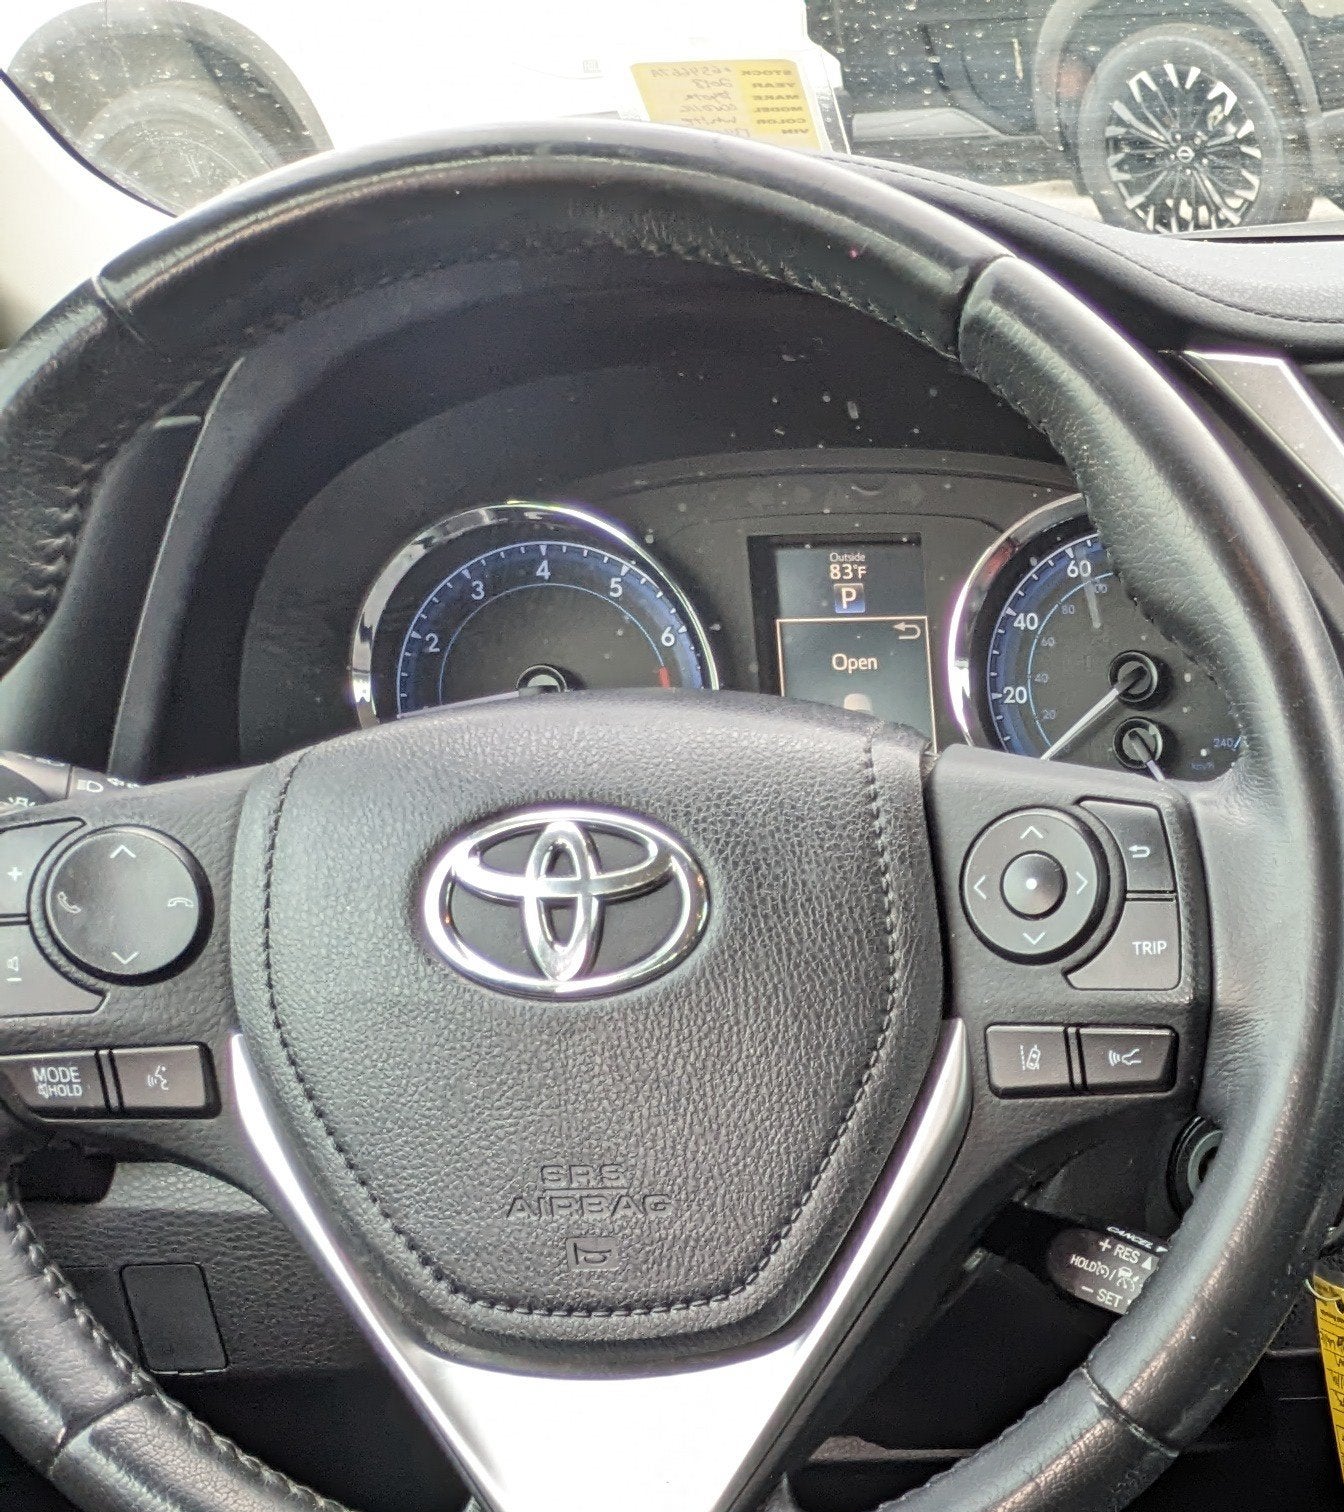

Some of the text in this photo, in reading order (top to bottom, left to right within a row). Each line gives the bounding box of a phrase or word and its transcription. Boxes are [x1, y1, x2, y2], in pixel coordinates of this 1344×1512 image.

[829, 552, 866, 562] Outside
[536, 561, 551, 579] 4
[1067, 560, 1092, 578] 60
[471, 580, 485, 600] 3
[609, 578, 623, 598] 5
[841, 587, 857, 609] P
[1061, 604, 1075, 615] 80
[1013, 612, 1039, 631] 40
[425, 633, 441, 653] 2
[661, 627, 675, 647] 6
[832, 653, 878, 673] Open
[1003, 687, 1028, 704] 20
[1131, 940, 1168, 956] TRIP
[32, 1066, 82, 1083] MODE
[49, 1084, 83, 1097] HOLD
[541, 1164, 625, 1185] SRS
[506, 1194, 672, 1218] AIRBAG
[1106, 1226, 1153, 1250] CANCEL
[1069, 1254, 1097, 1273] HOLD
[1113, 1244, 1141, 1264] RES
[1096, 1288, 1123, 1308] SET
